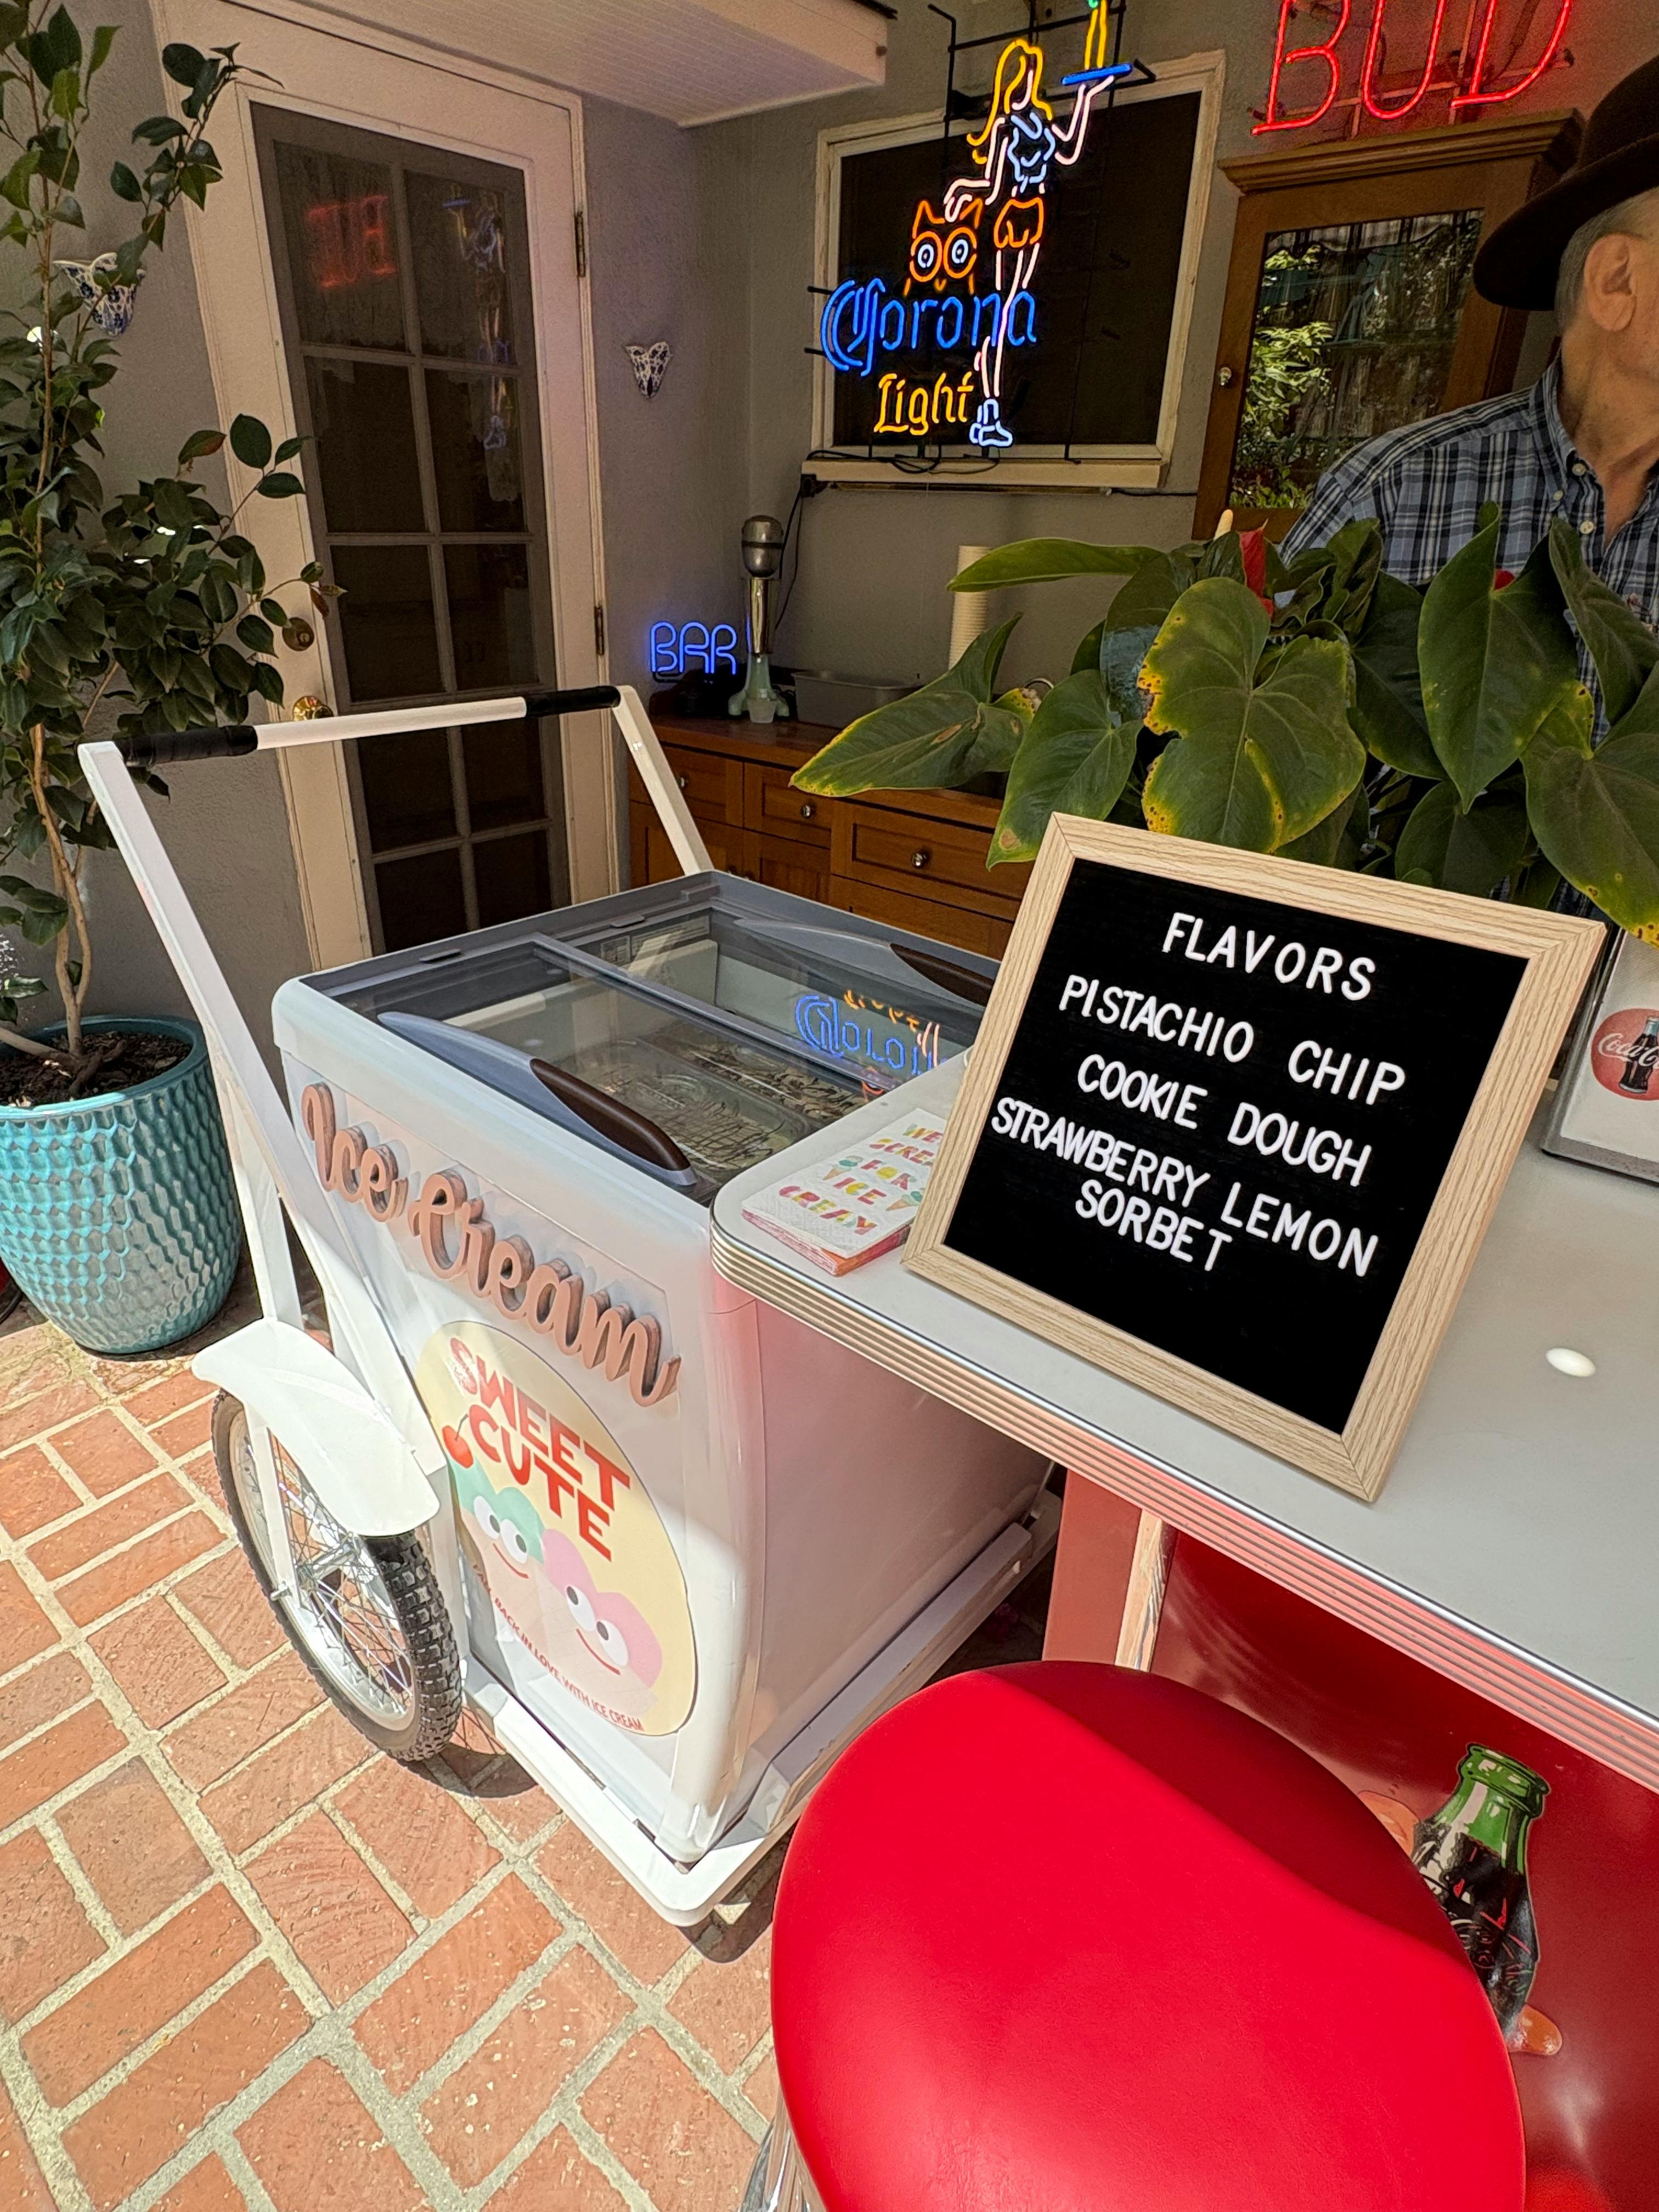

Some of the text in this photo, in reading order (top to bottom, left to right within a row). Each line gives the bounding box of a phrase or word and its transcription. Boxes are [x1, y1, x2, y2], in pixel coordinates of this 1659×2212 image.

[1251, 0, 1571, 136] BUD
[820, 278, 1036, 376] Corona
[874, 371, 974, 436] Light
[650, 620, 737, 675] BAR
[1161, 912, 1376, 1000] FLAVORS
[1059, 974, 1406, 1105] PISTACHIO CHIP
[860, 1159, 917, 1190] FOR
[1077, 1054, 1372, 1187] COOKIE DOUGH
[779, 1186, 878, 1235] CREAM
[833, 1177, 887, 1205] ICE
[991, 1097, 1379, 1277] STRAWBERRY LEMON
[1075, 1180, 1232, 1272] SORBET
[301, 1082, 681, 1407] Ice Cream
[450, 1338, 630, 1511] SWEET
[468, 1404, 612, 1562] CUTE
[494, 1597, 521, 1633] BACK
[534, 1648, 562, 1683] LOVE
[562, 1676, 591, 1708] WITH
[591, 1699, 608, 1718] ICE
[608, 1709, 645, 1732] CREAM
